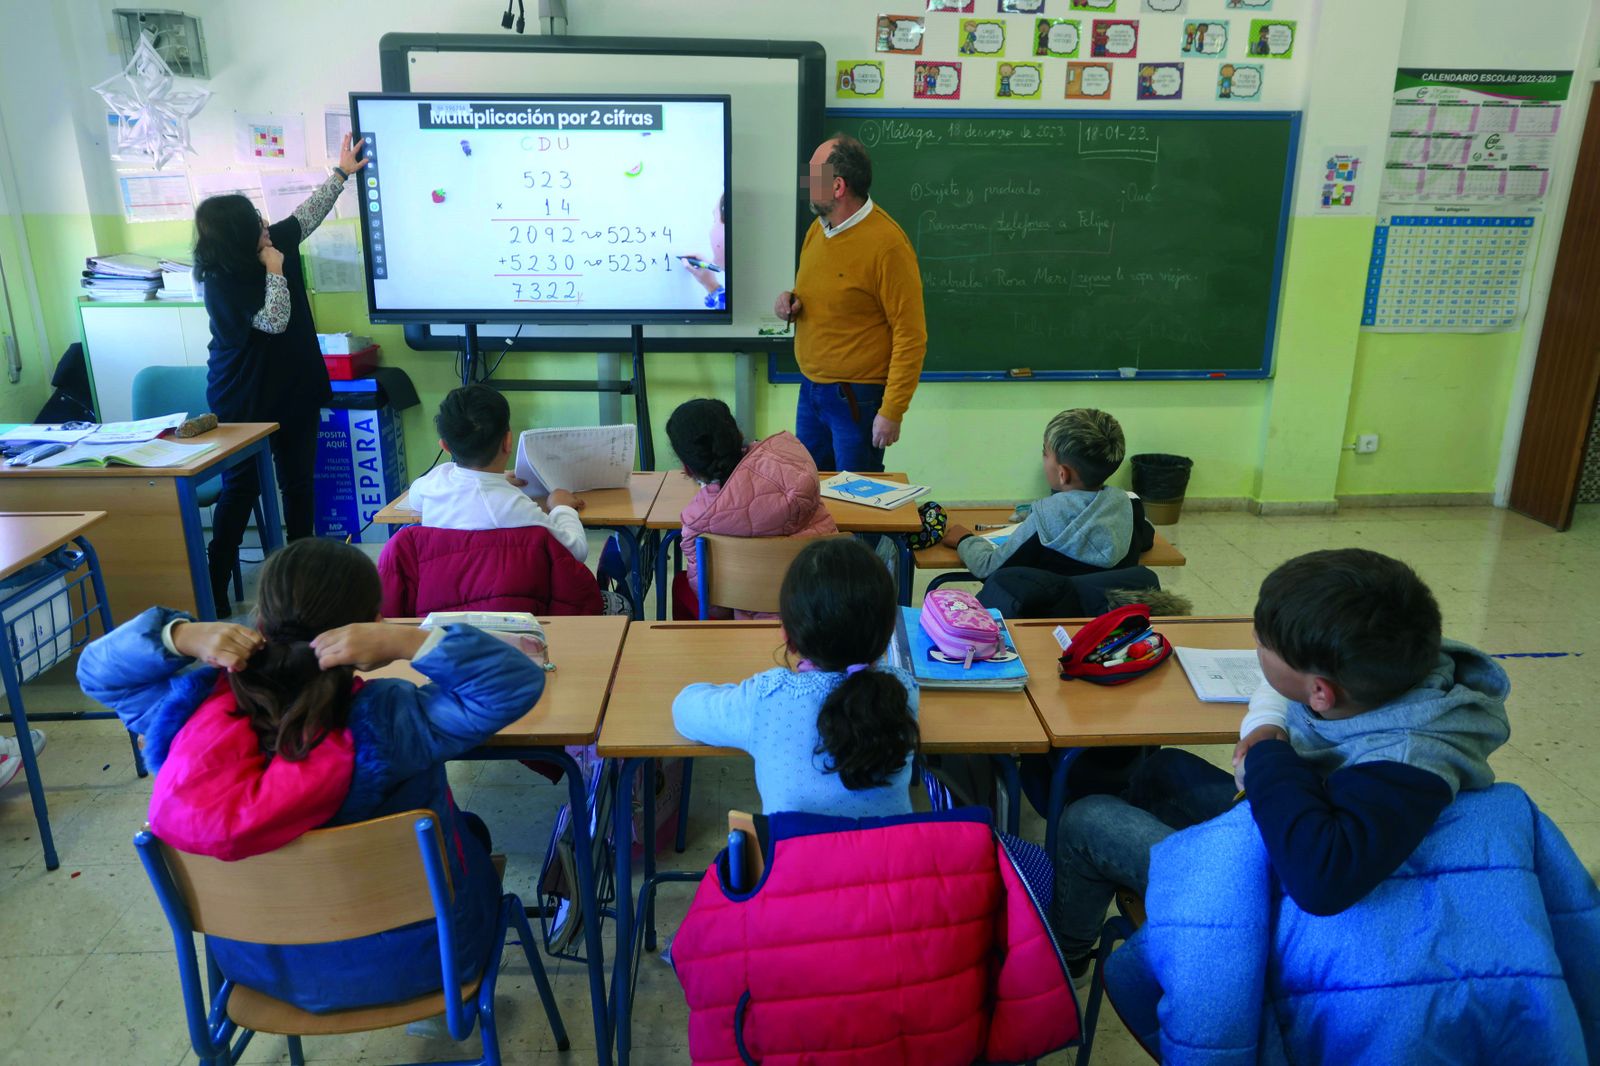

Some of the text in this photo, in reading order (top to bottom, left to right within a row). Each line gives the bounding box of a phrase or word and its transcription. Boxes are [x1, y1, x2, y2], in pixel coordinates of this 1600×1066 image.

[1422, 73, 1557, 83] CALENDARIO ESCOLAR 2022-2023
[430, 108, 554, 129] Multiplicación
[558, 112, 588, 130] por
[590, 110, 601, 125] 2
[603, 110, 654, 126] cifras
[538, 136, 552, 152] D
[558, 136, 570, 152] U
[326, 440, 348, 448] AQUÍ:
[354, 417, 382, 522] SEPARA
